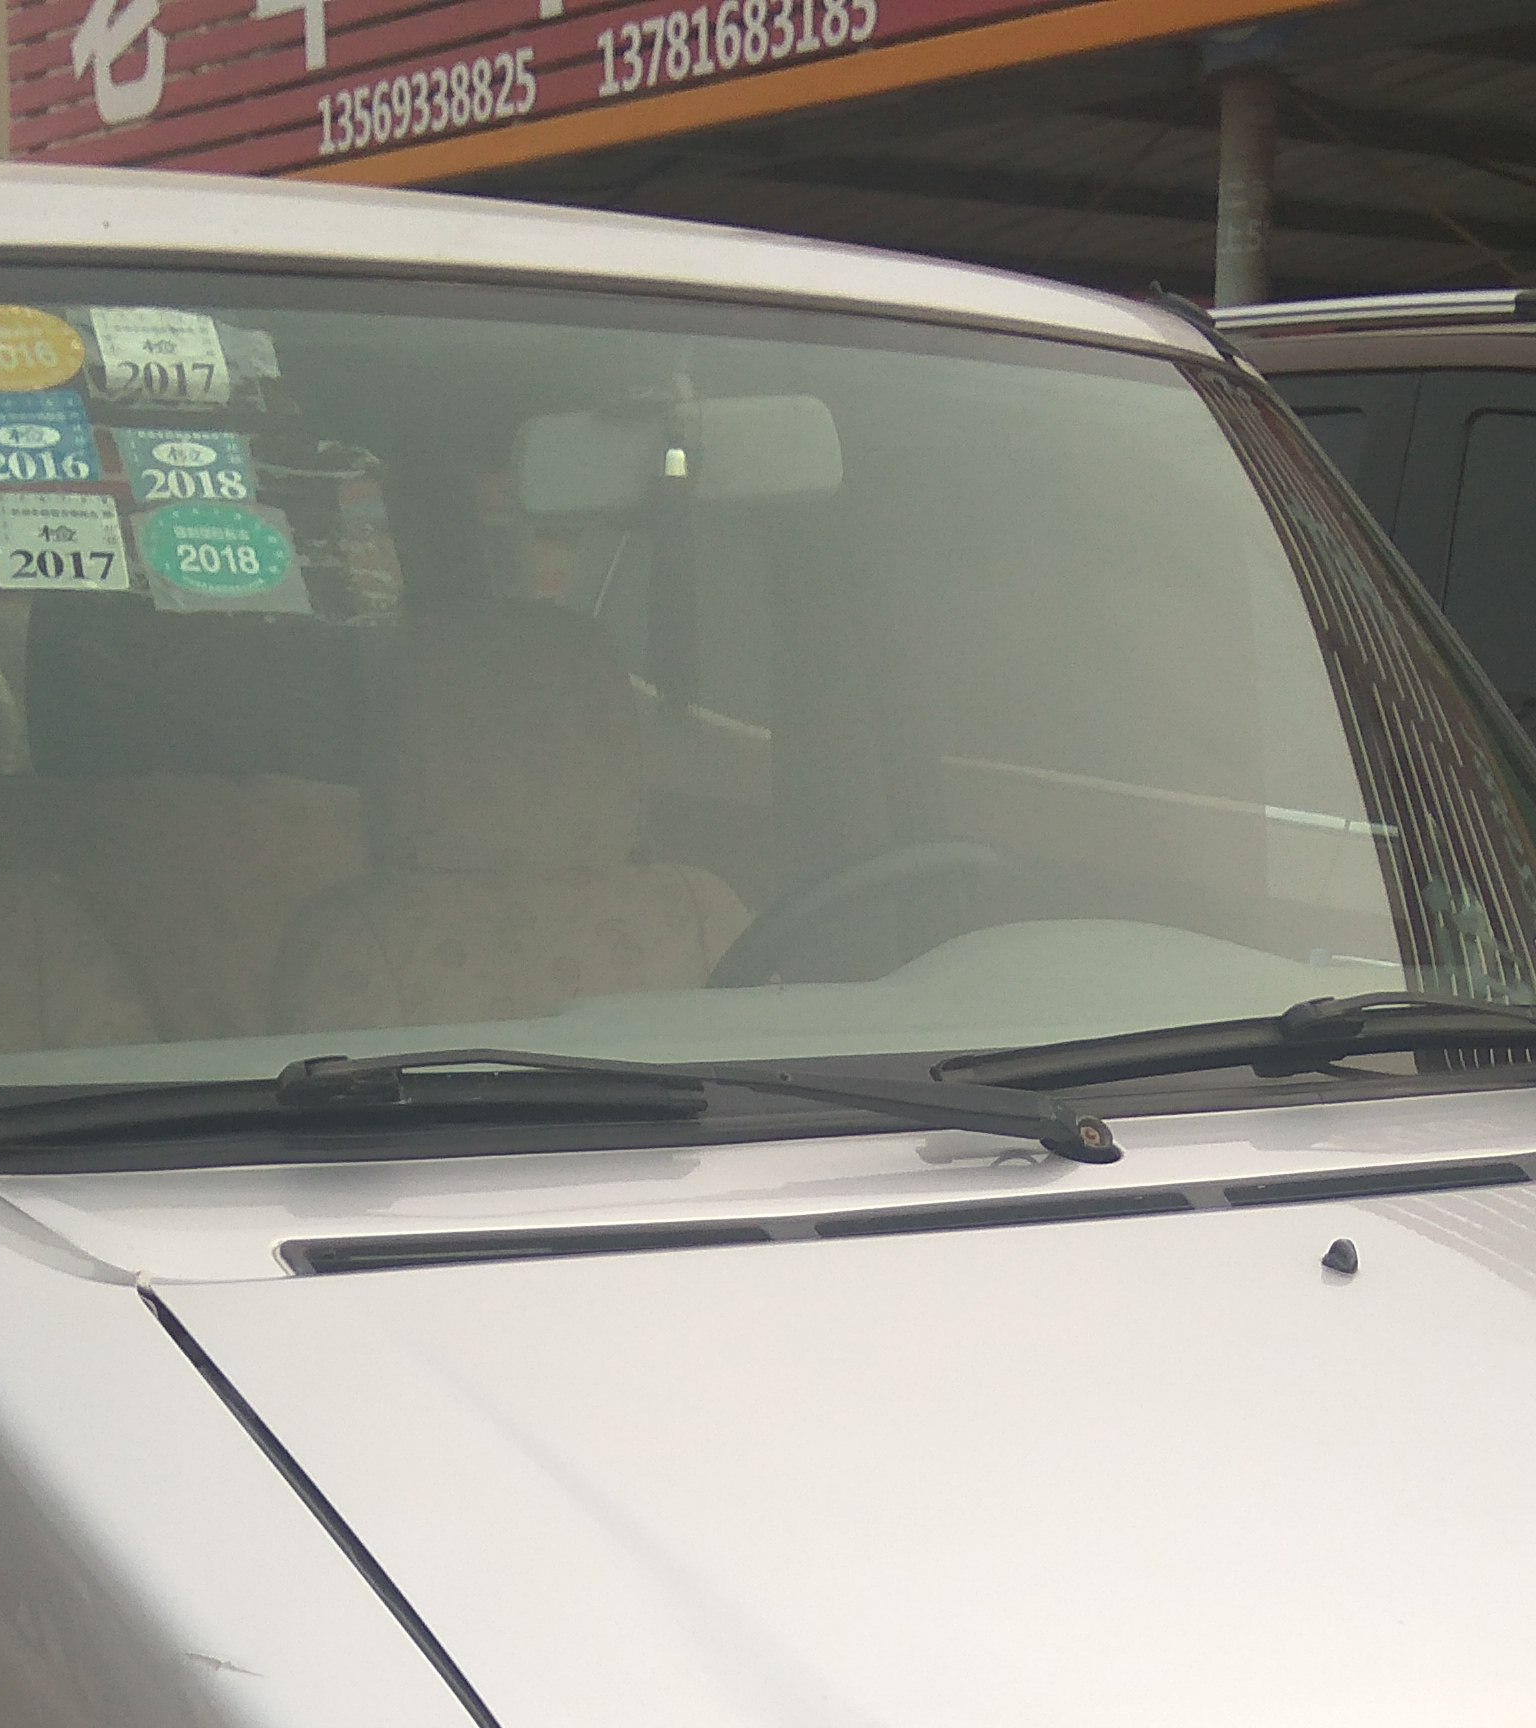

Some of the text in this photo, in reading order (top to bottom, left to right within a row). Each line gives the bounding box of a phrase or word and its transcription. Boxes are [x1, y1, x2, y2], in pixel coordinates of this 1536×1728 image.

[317, 0, 878, 156] 13569338825 13781683185
[113, 361, 215, 399] 2017
[140, 468, 249, 500] 2018
[9, 548, 116, 581] 2017
[176, 543, 260, 575] 2018
